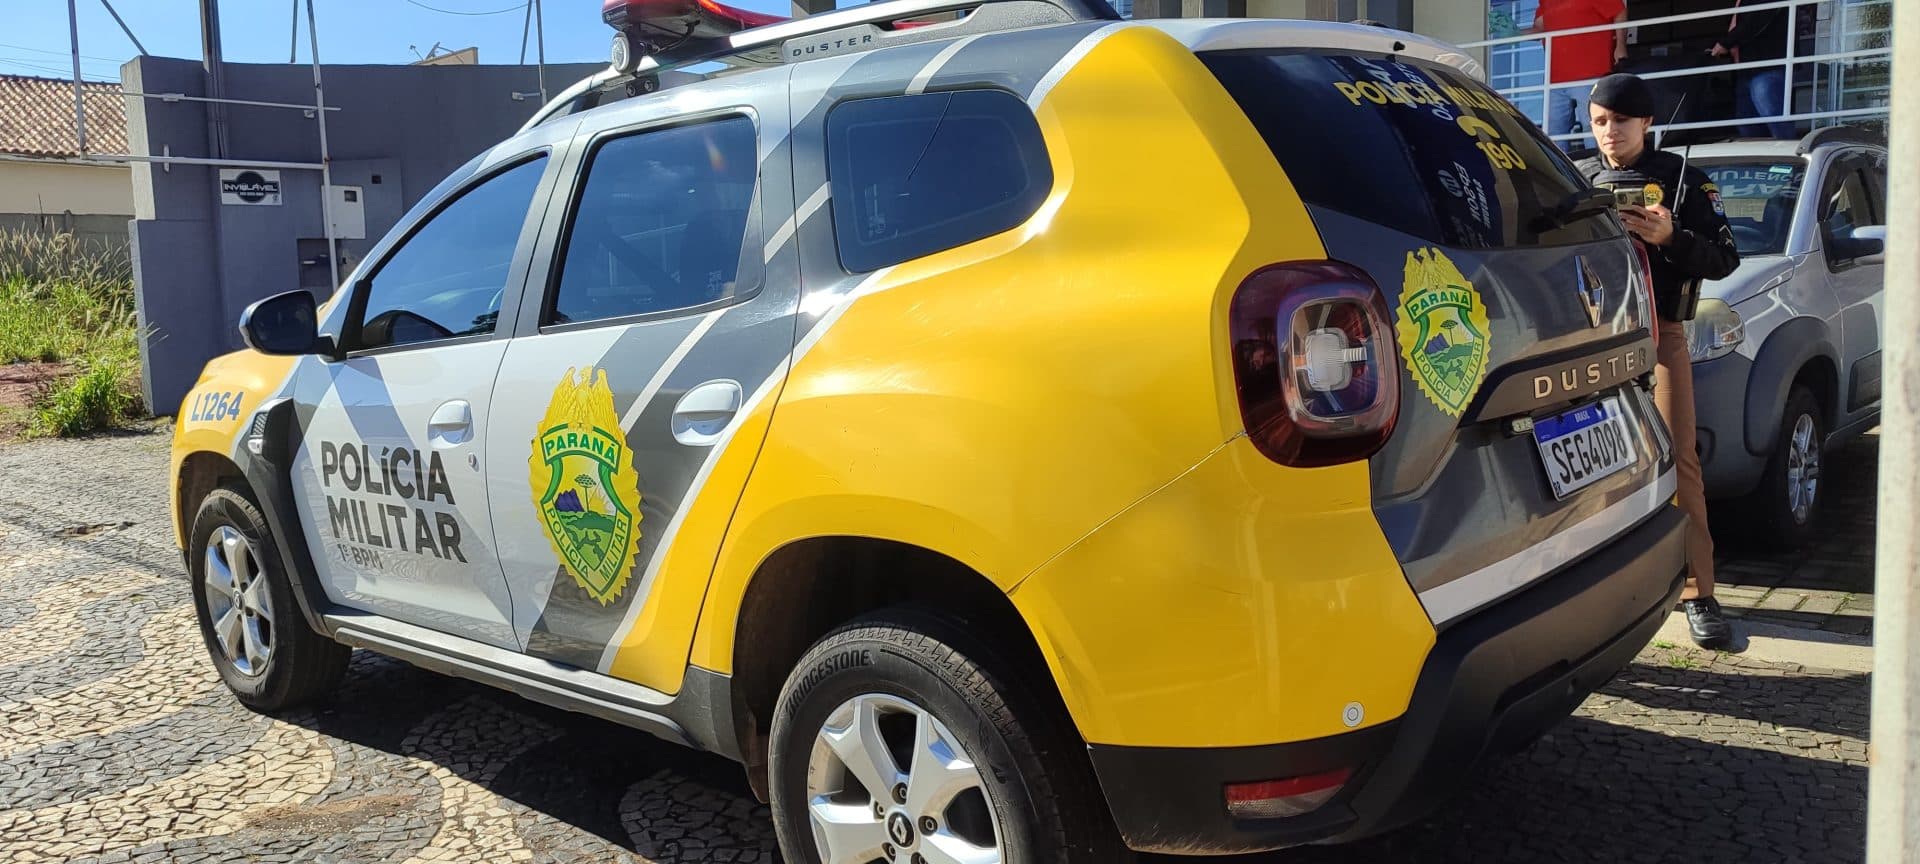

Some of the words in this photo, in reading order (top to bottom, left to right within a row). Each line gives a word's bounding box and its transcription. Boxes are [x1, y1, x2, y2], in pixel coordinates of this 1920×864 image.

[792, 34, 872, 57] DUSTER
[1476, 141, 1526, 170] 190
[1411, 291, 1471, 317] PARANÁ
[1459, 341, 1482, 396] MILITAR
[1534, 347, 1647, 399] DUSTER
[191, 391, 244, 421] L1264
[545, 432, 616, 465] PARANÁ
[1551, 419, 1629, 485] SEG4D98
[326, 495, 468, 564] MILITAR
[352, 546, 384, 570] BPM
[599, 521, 627, 583] MILITAR
[785, 649, 870, 720] BRIDGESTONE
